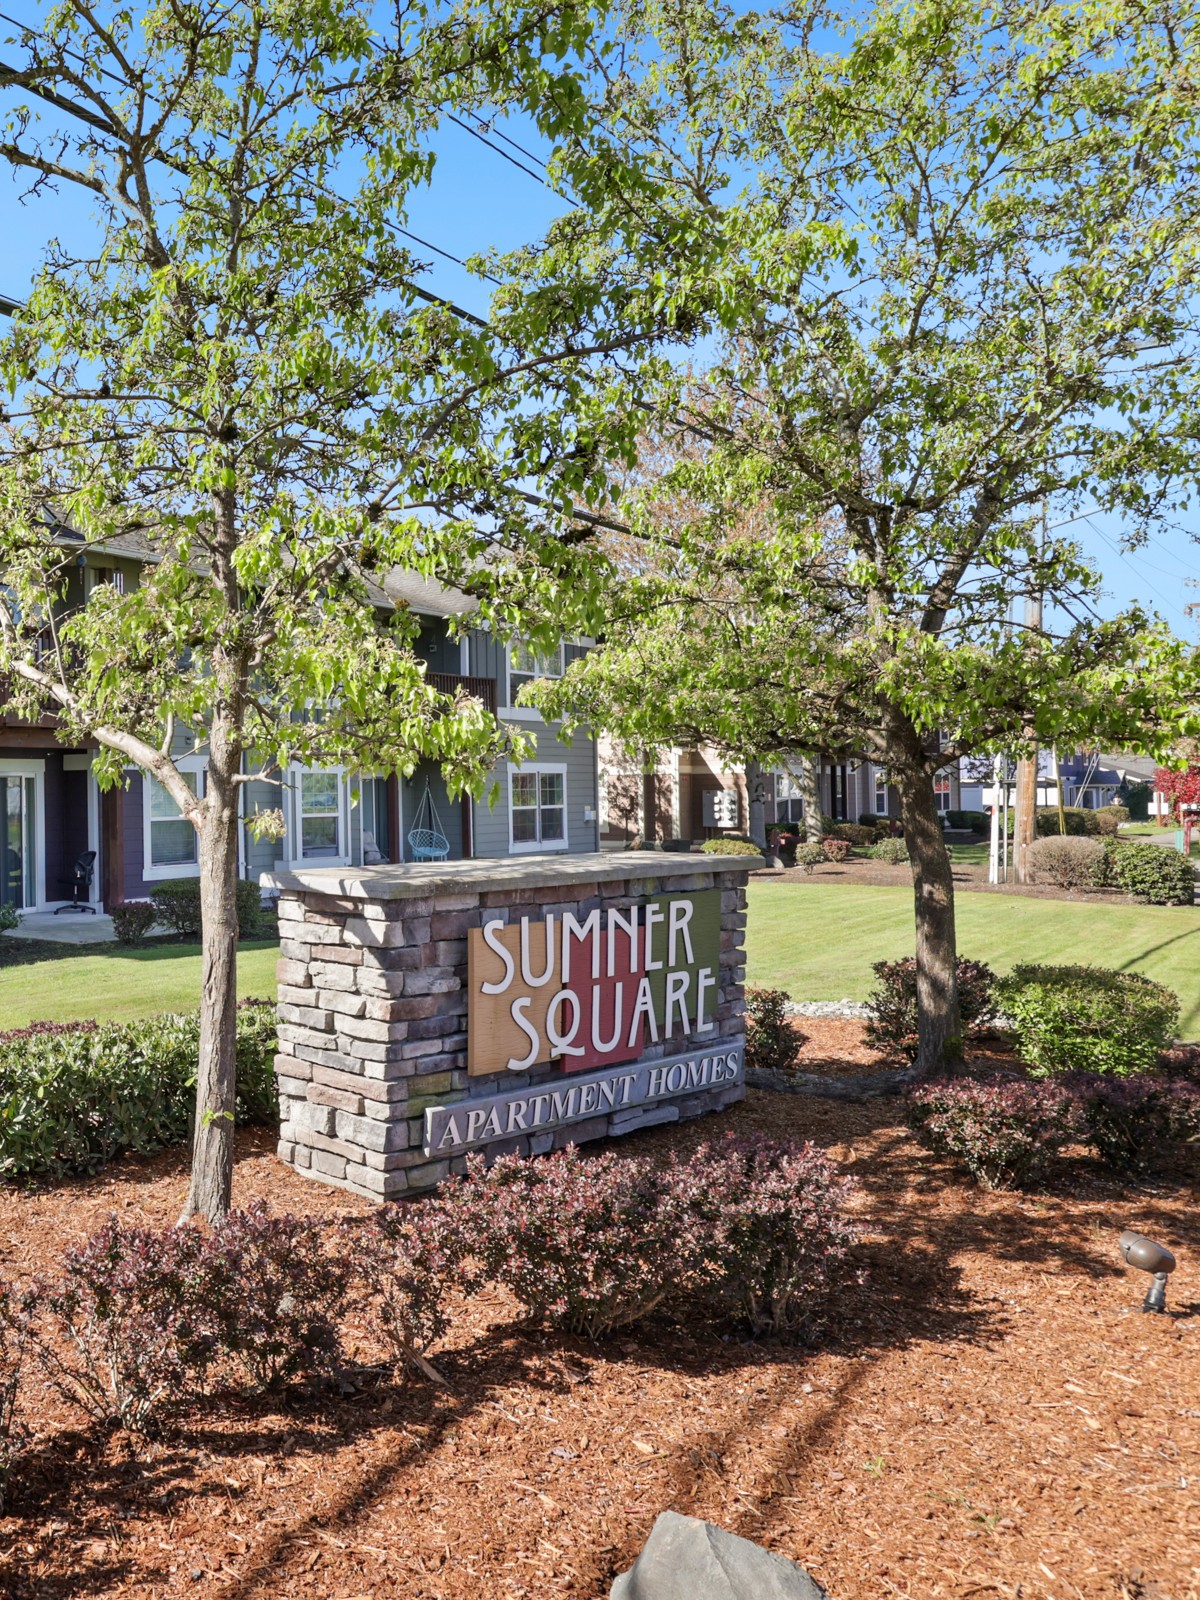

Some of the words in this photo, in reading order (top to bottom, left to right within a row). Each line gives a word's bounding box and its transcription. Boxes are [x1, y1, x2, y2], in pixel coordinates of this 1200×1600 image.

[481, 899, 695, 995] SUMNER
[507, 967, 716, 1071] SQUARE
[437, 1075, 636, 1149] APARTMENT
[648, 1050, 739, 1098] HOMES
